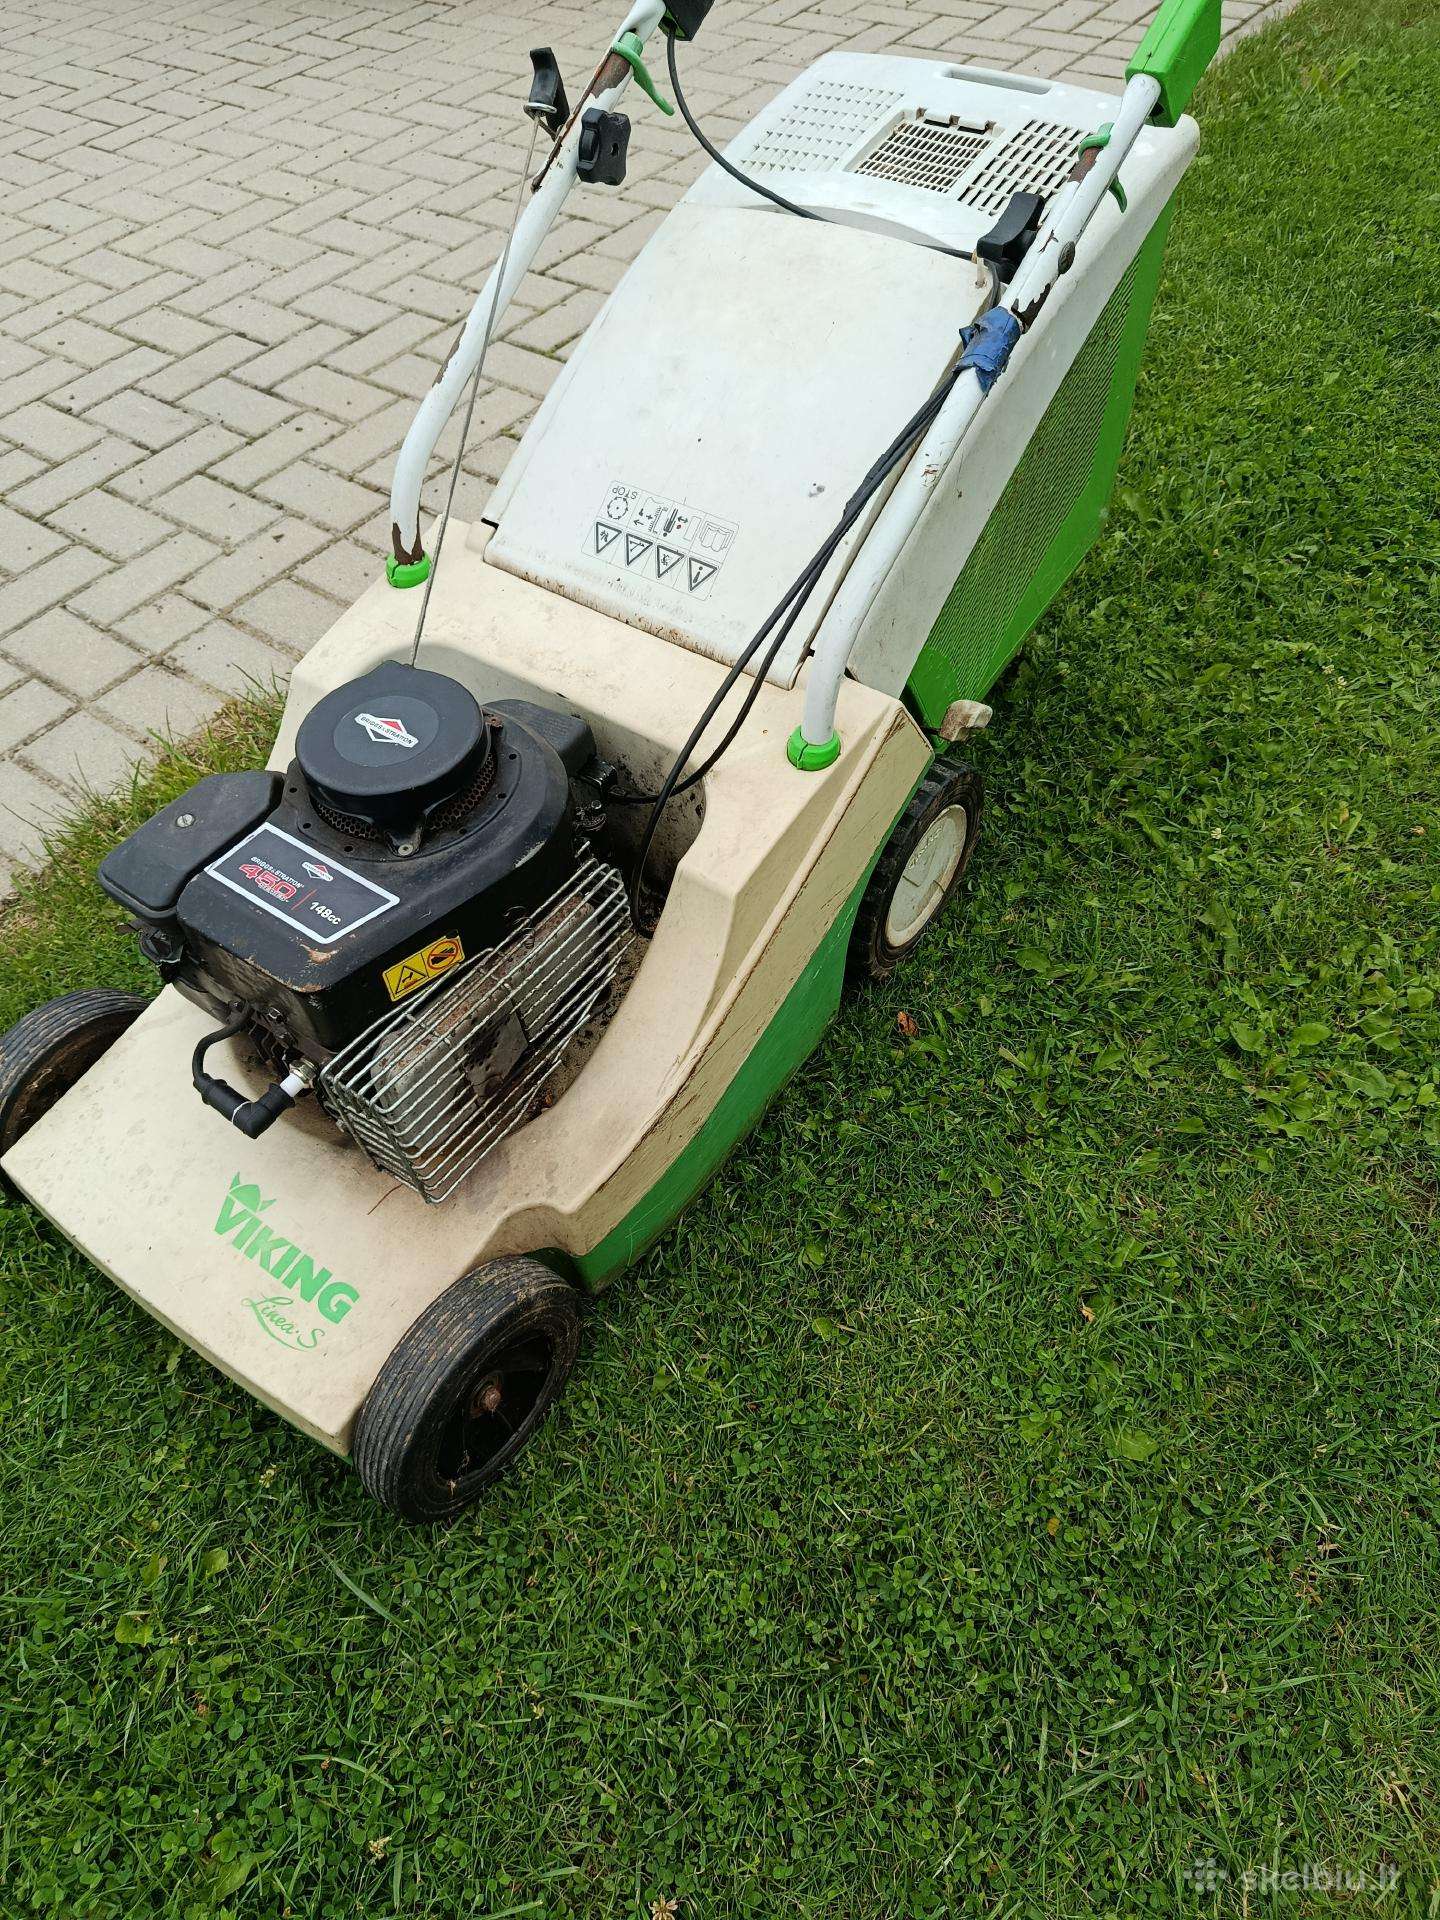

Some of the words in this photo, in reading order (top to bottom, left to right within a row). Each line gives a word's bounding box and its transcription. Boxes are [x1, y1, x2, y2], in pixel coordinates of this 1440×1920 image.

[612, 486, 638, 499] STOP
[238, 864, 297, 900] 450
[309, 902, 341, 925] 148cc
[214, 1194, 360, 1325] VIKING
